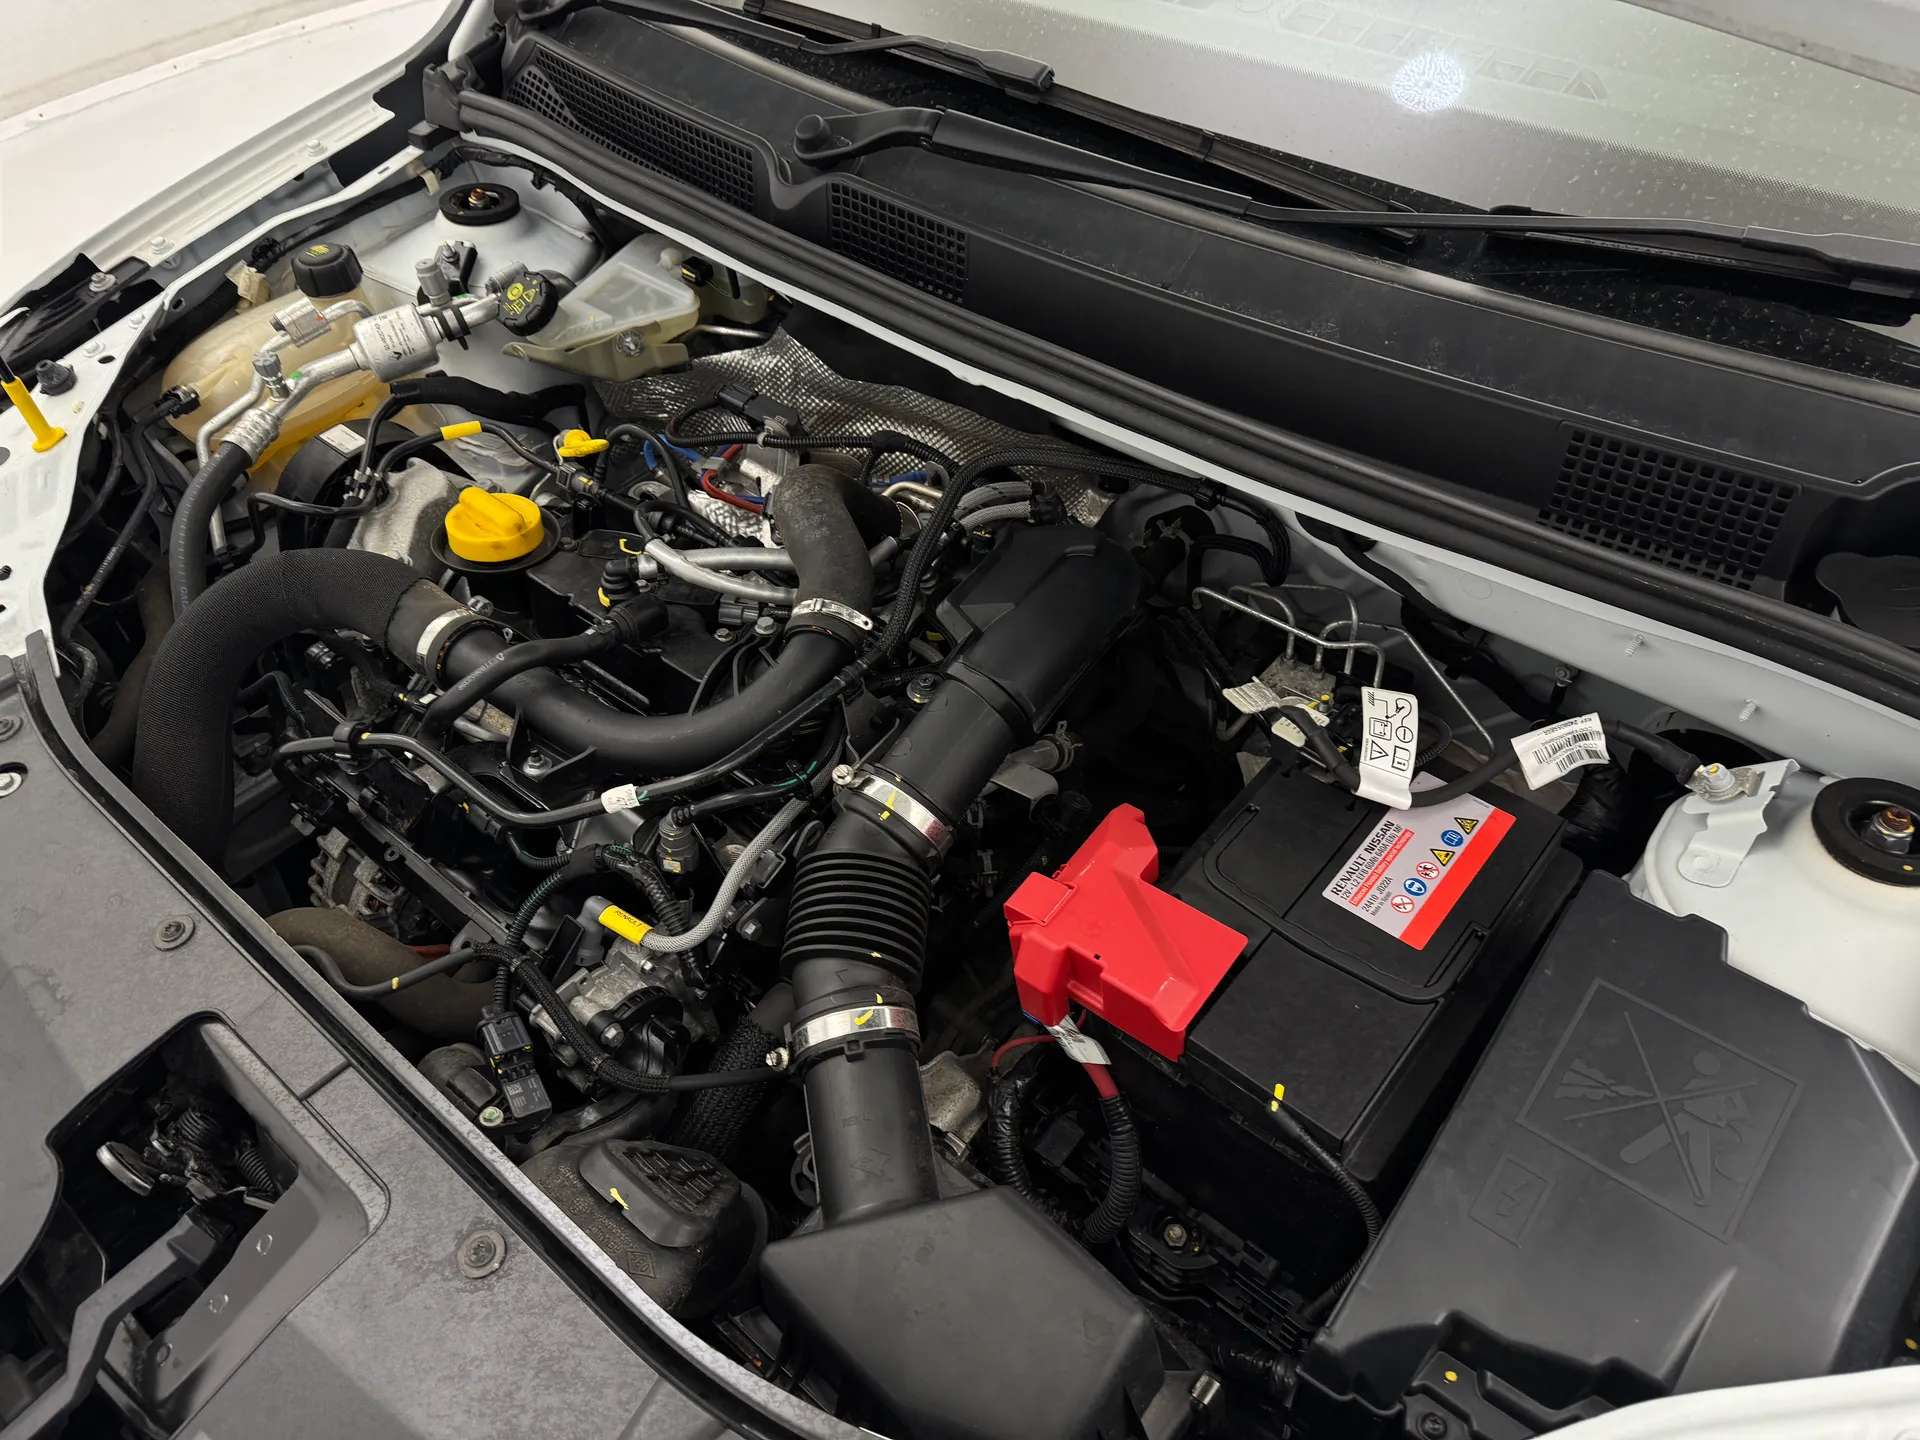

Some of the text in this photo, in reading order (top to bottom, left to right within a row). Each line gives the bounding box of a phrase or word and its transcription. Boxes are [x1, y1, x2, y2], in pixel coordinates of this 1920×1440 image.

[1331, 853, 1368, 896] RENAULT
[1364, 820, 1395, 854] NISSAN
[1340, 887, 1353, 901] 12V
[1361, 894, 1380, 913] 24410
